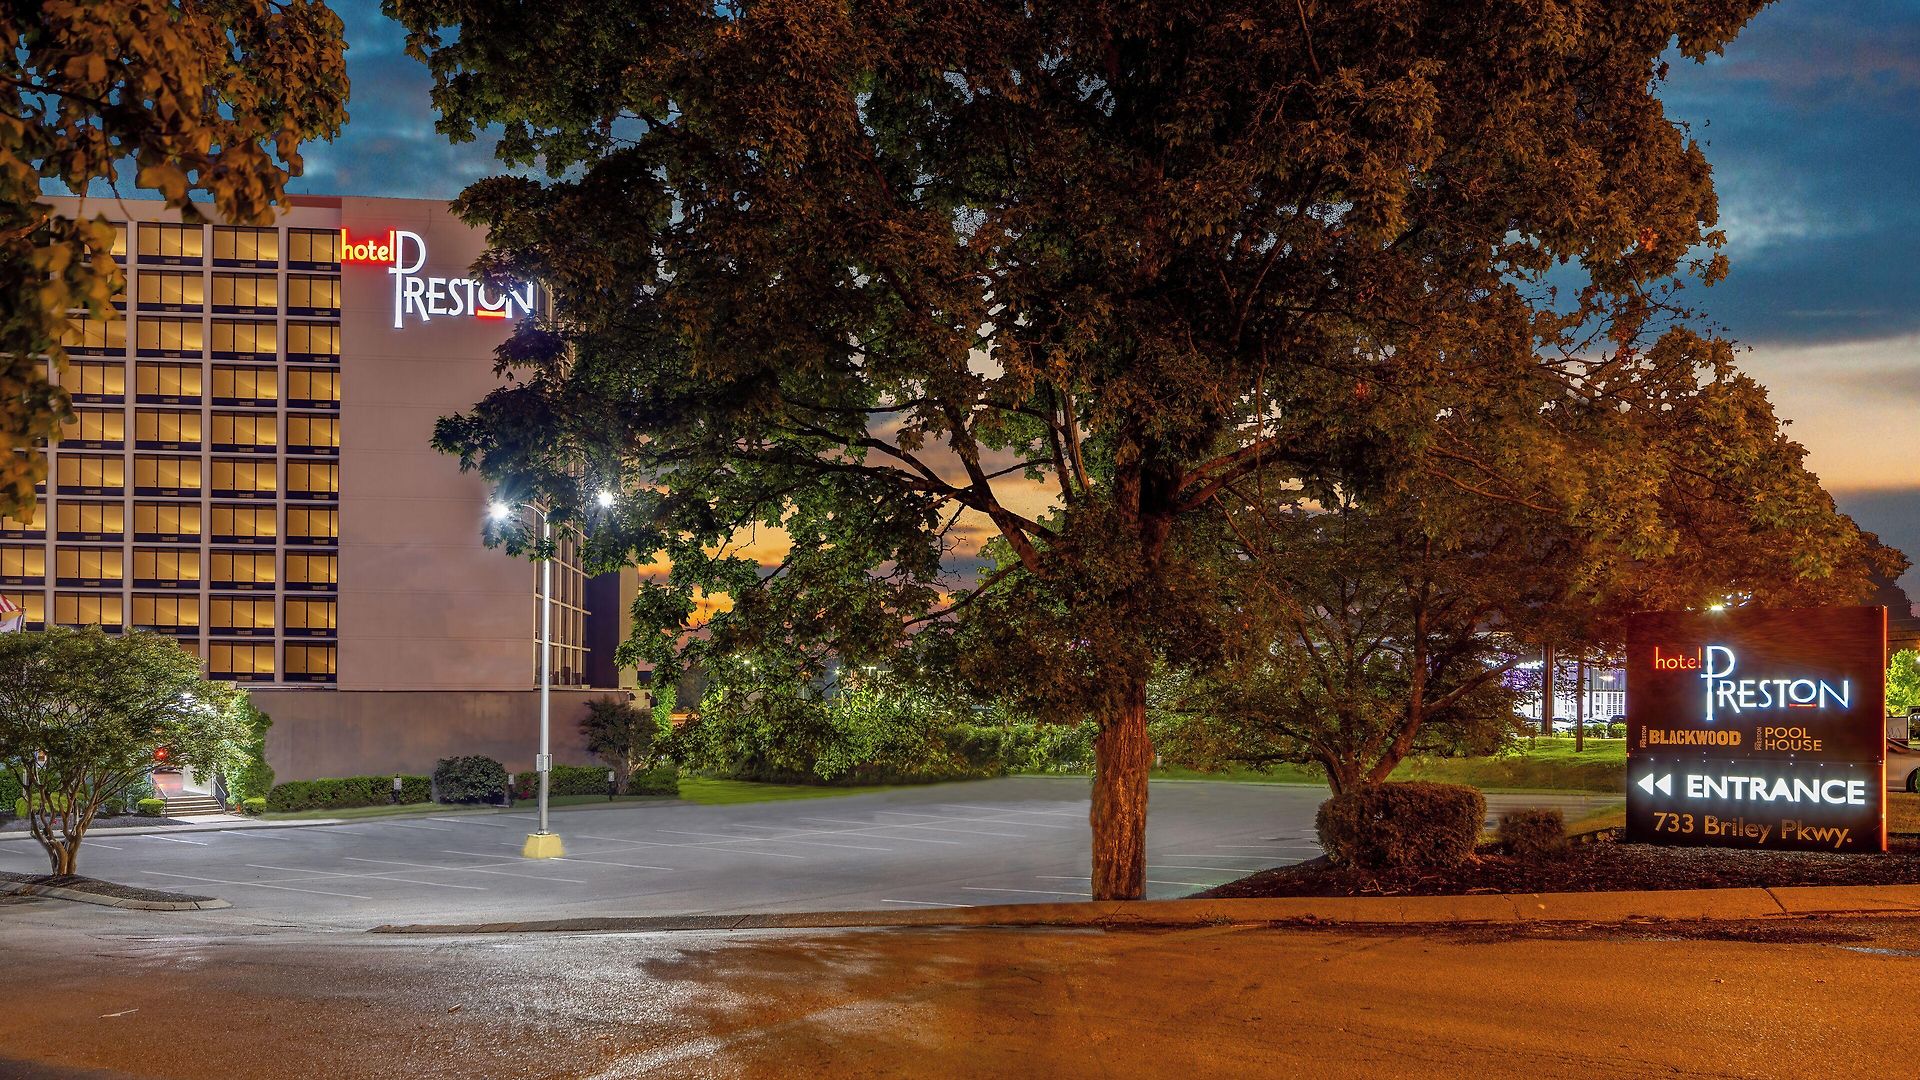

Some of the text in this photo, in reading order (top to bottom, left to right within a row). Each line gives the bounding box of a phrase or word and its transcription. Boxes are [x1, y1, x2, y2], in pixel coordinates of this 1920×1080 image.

[341, 228, 395, 262] hotel
[388, 230, 534, 329] PRESTON
[1655, 646, 1702, 669] hotel
[1701, 645, 1849, 721] PRESTON
[1649, 729, 1742, 746] BLACKWOOD
[1765, 727, 1811, 739] POOL
[1765, 739, 1822, 751] HOUSE
[1687, 774, 1865, 805] ENTRANCE
[1654, 812, 1853, 849] 733 Briley Pkwy.
